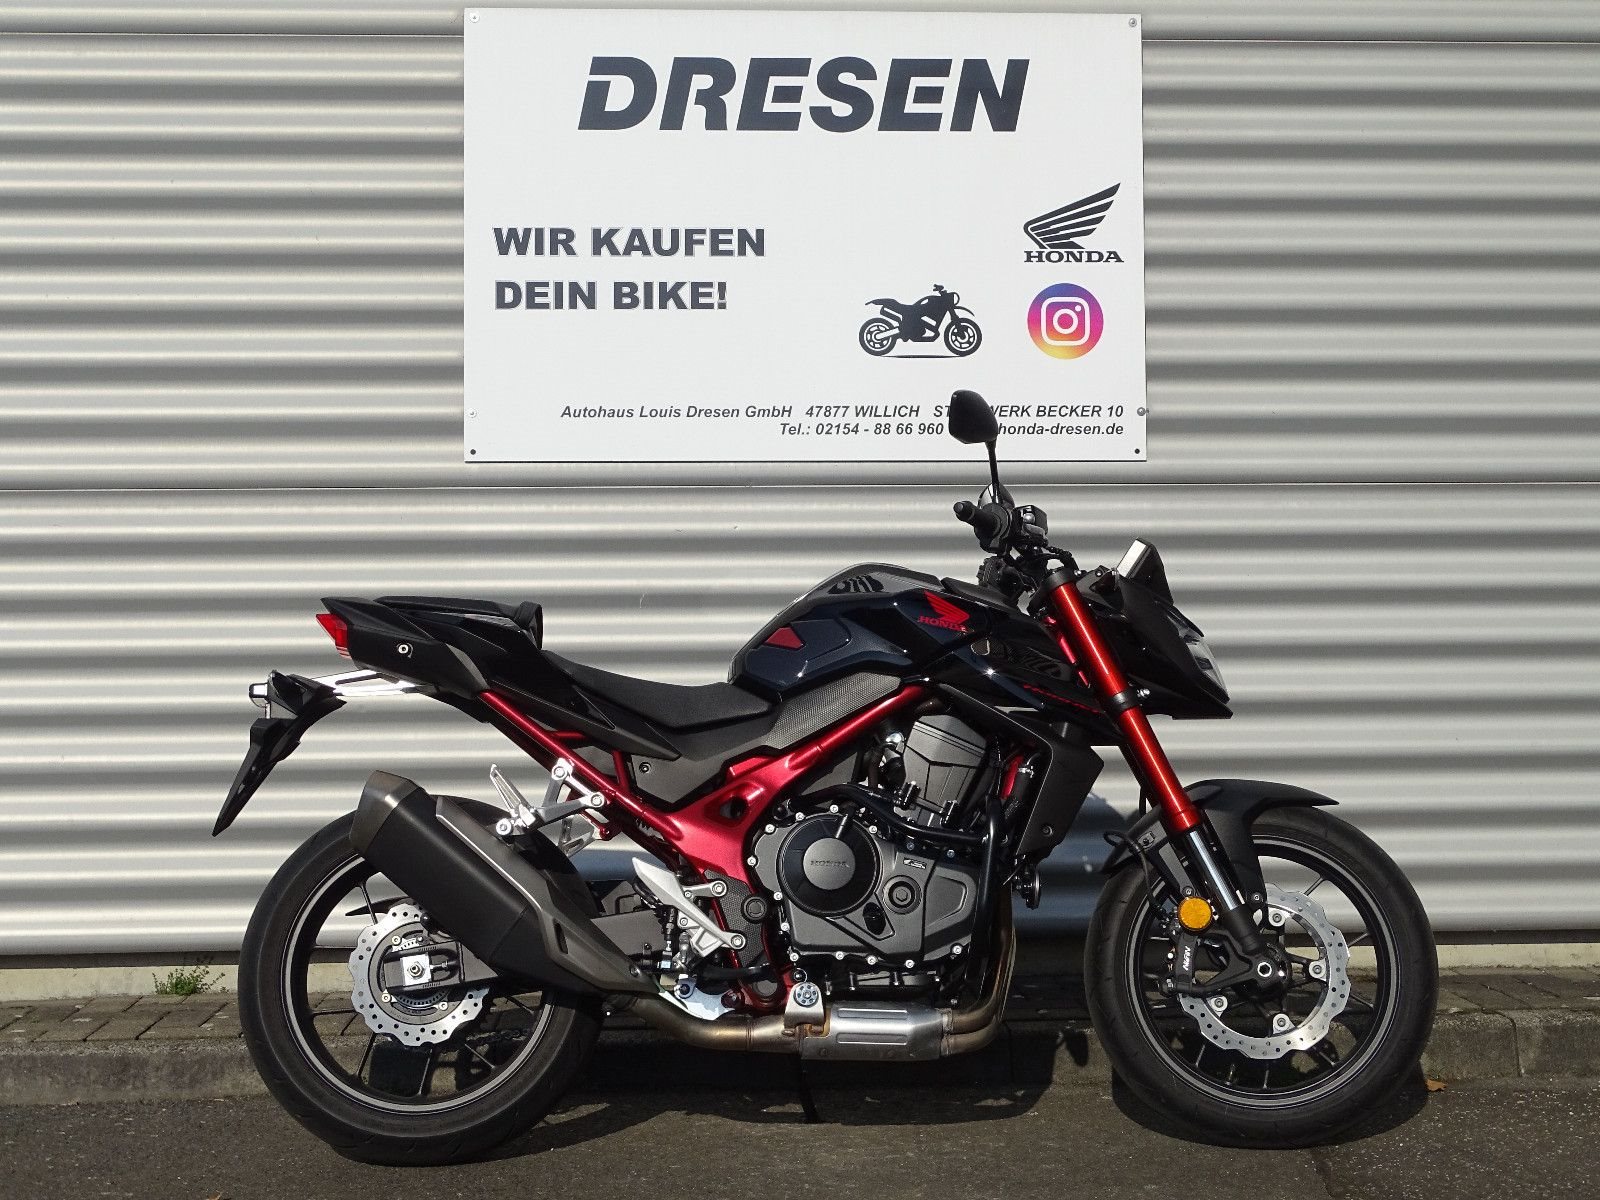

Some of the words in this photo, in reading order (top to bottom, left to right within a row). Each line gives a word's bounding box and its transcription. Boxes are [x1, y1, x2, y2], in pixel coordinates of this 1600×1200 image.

[578, 57, 1030, 133] DRESEN
[492, 227, 577, 257] WIR
[592, 228, 766, 258] KAUFEN
[1023, 250, 1124, 263] HONDA
[494, 281, 597, 310] DEIN
[613, 281, 727, 310] BIKE!
[561, 405, 634, 418] Autohaus
[640, 405, 681, 418] Louis
[686, 405, 739, 418] Dresen
[745, 405, 792, 418] GmbH
[806, 405, 850, 418] 47877
[855, 404, 921, 418] WILLICH
[1036, 404, 1102, 418] BECKER
[1107, 404, 1124, 418] 10
[780, 422, 810, 436] Tel.:
[815, 422, 859, 436] 02154
[874, 422, 892, 436] 88
[896, 422, 914, 436] 66
[917, 422, 944, 435] 960
[965, 422, 1124, 436] honda-dresen.de
